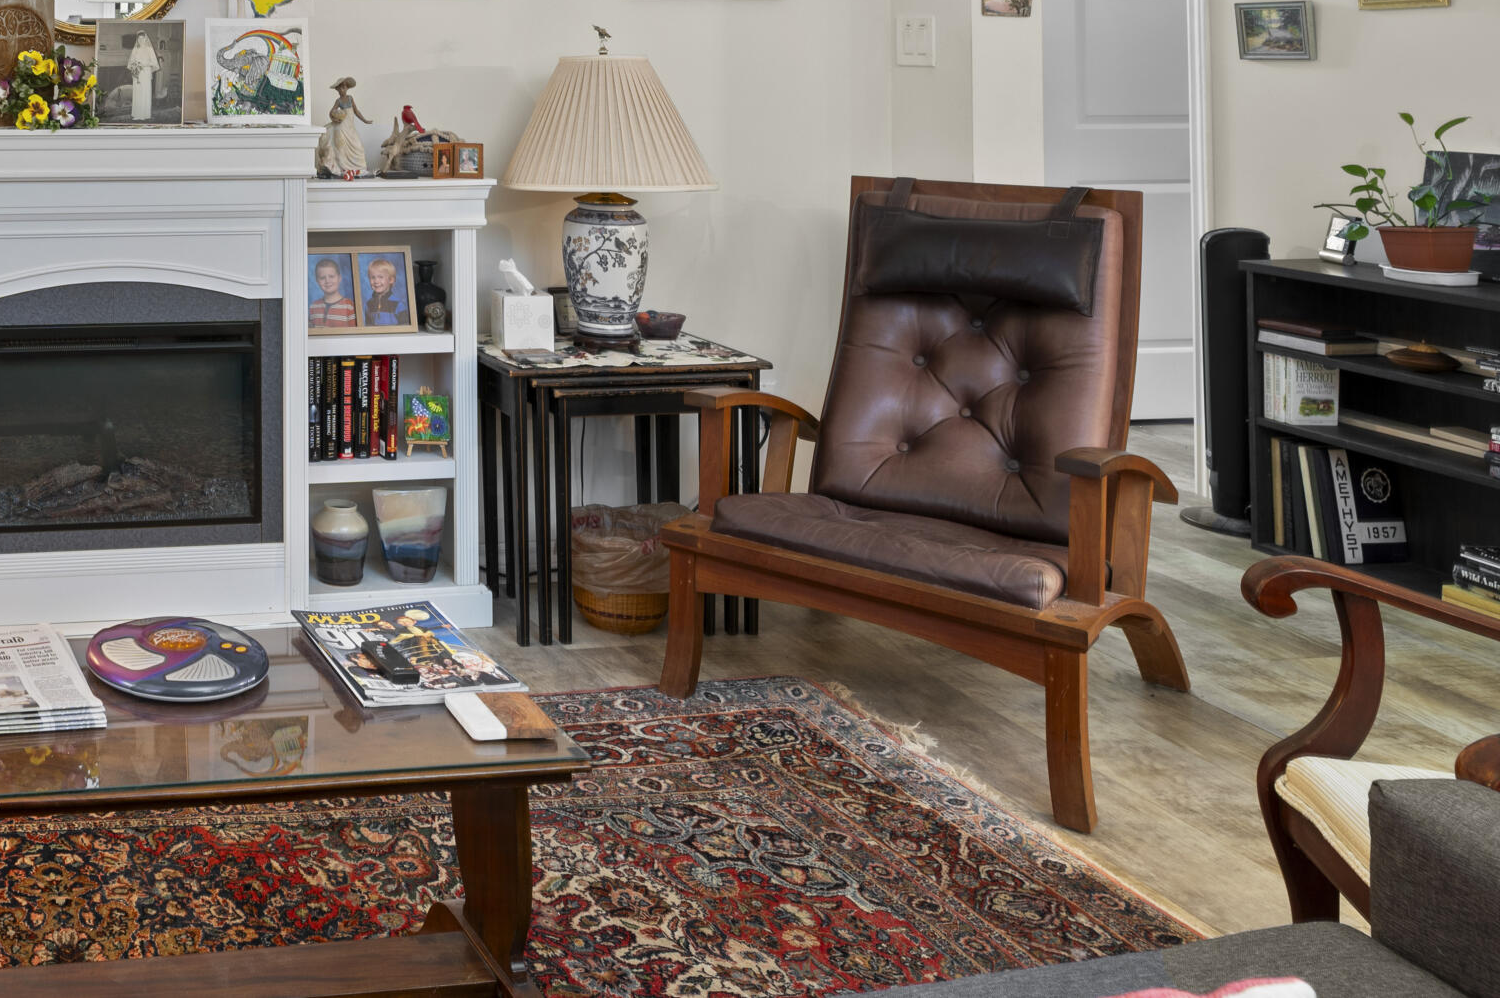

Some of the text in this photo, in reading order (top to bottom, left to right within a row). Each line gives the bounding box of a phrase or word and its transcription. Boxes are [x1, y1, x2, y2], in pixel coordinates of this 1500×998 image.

[1296, 361, 1324, 371] JAMES
[1295, 370, 1334, 383] HERRIOT
[1335, 457, 1358, 559] AMETHYST
[1367, 526, 1397, 539] 1957
[1461, 569, 1500, 590] Wild Ani
[307, 613, 381, 625] MAD
